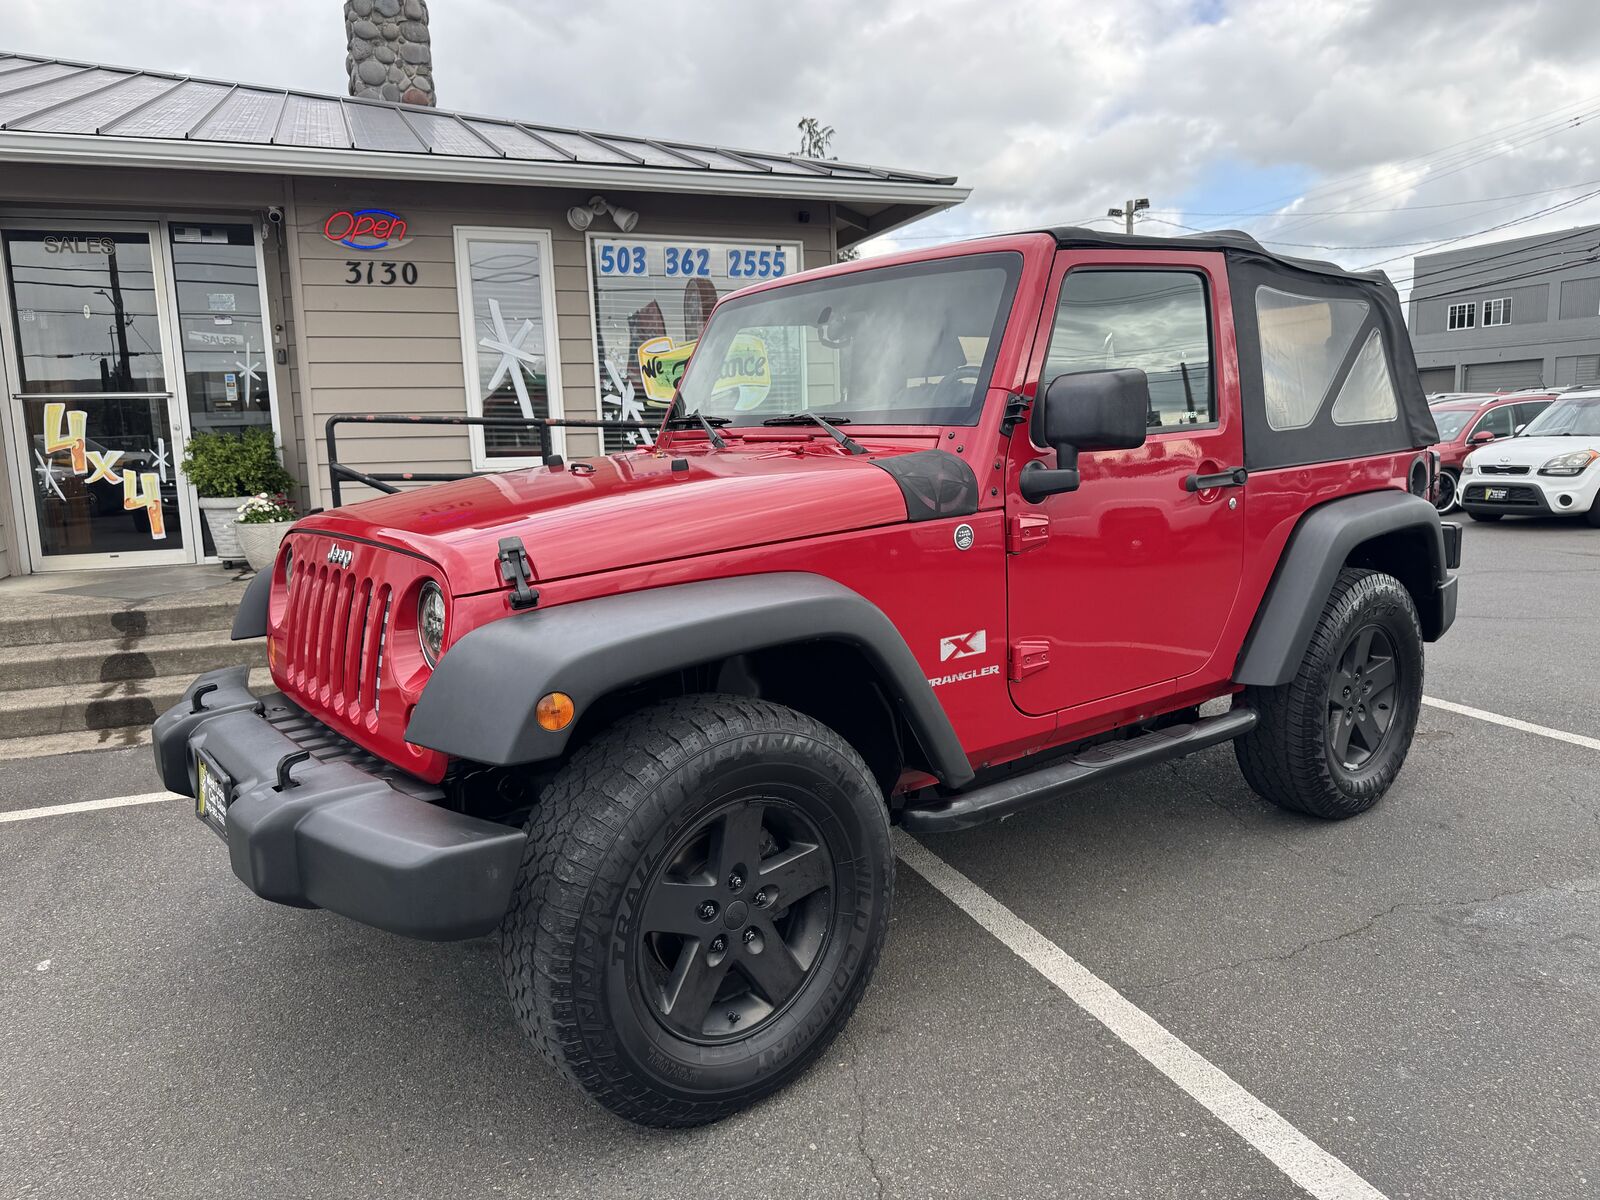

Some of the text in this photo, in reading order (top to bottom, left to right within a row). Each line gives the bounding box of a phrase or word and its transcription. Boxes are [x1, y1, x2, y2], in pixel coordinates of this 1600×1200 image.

[325, 211, 407, 243] Open
[44, 236, 116, 255] SALES
[345, 261, 418, 285] 3130
[600, 245, 786, 278] 503 362 2555
[641, 356, 664, 379] We
[327, 543, 353, 570] Jeep
[940, 629, 986, 662] X
[927, 664, 1000, 688] RANGLER
